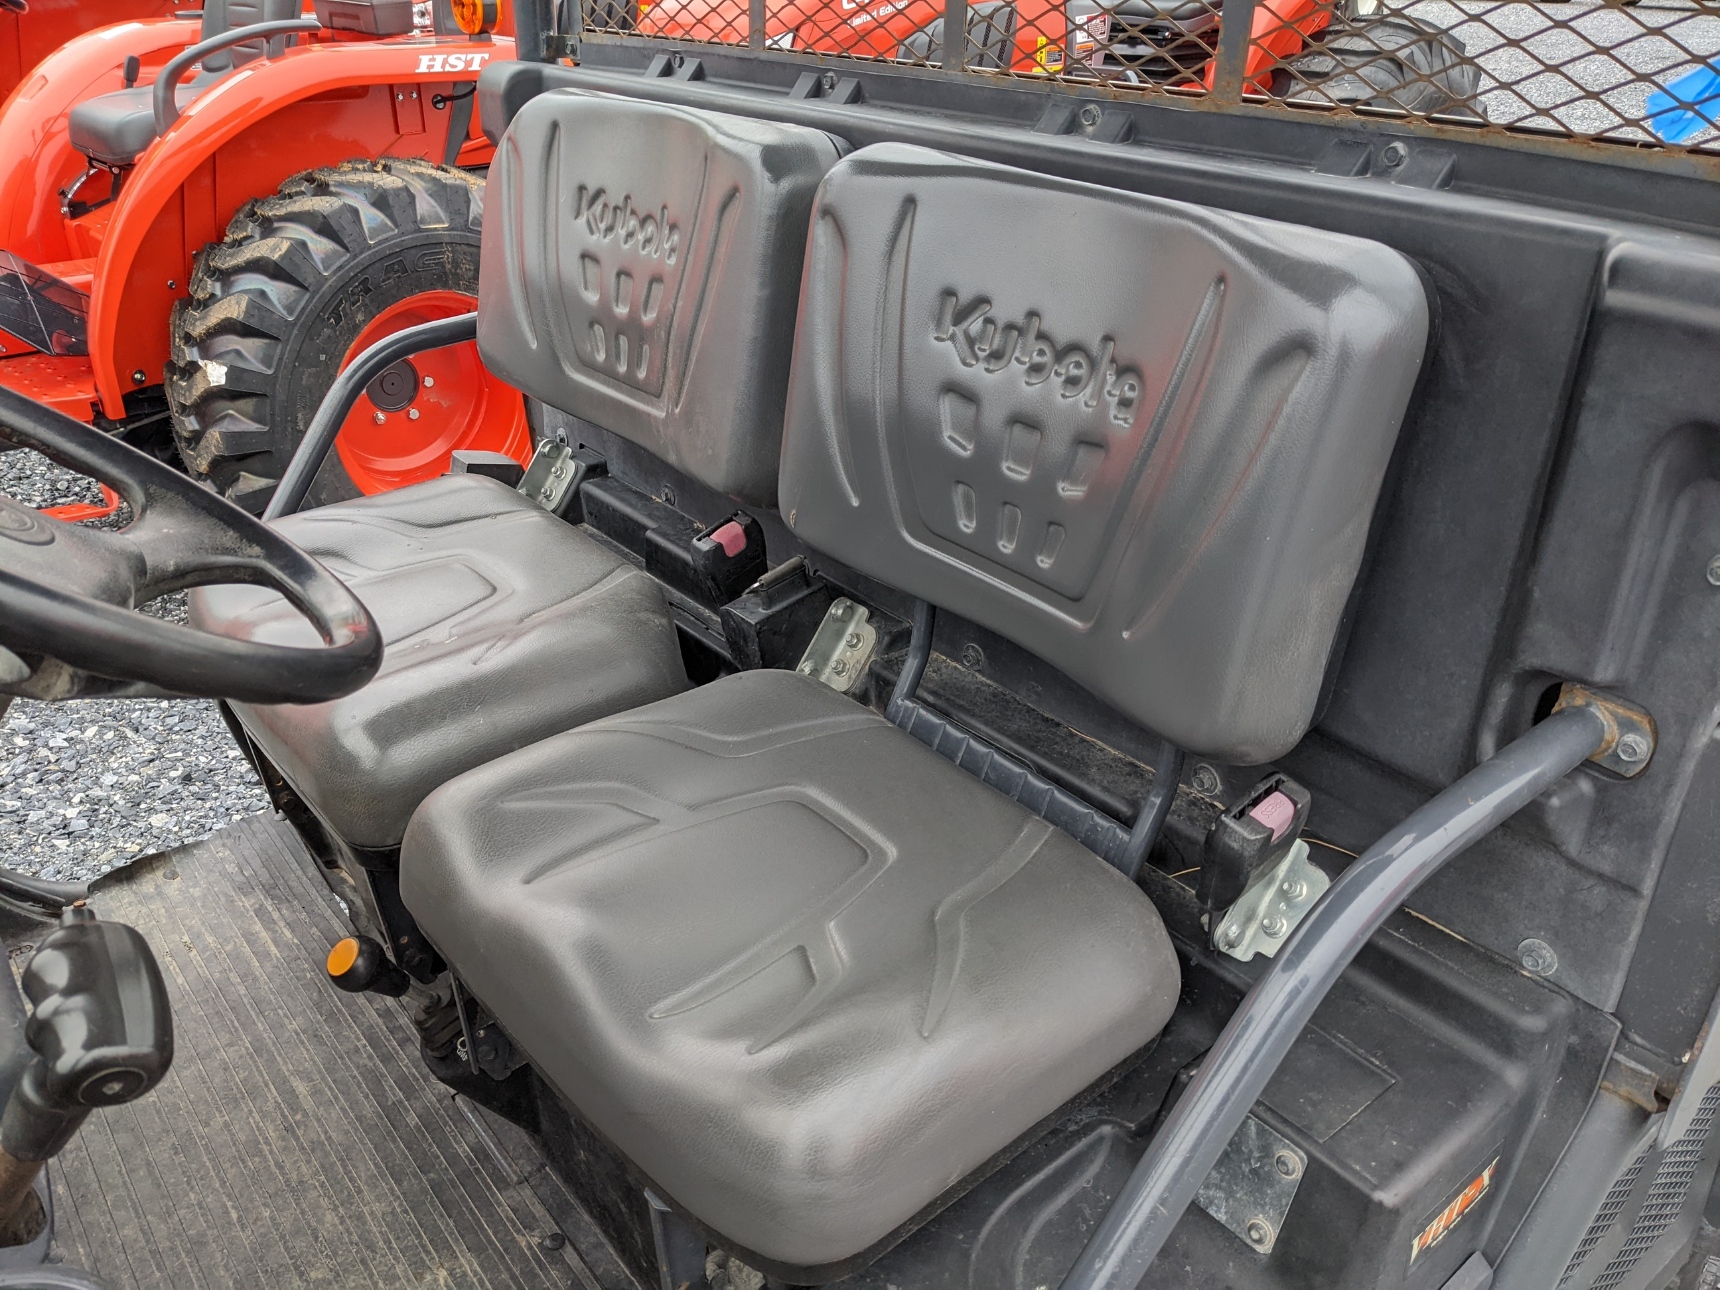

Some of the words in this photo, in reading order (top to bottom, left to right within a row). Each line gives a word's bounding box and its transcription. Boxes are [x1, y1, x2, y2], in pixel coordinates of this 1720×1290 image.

[415, 53, 489, 73] HST
[574, 184, 680, 266] Kubota
[933, 288, 1145, 428] Kubota
[1261, 799, 1286, 819] PRESS
